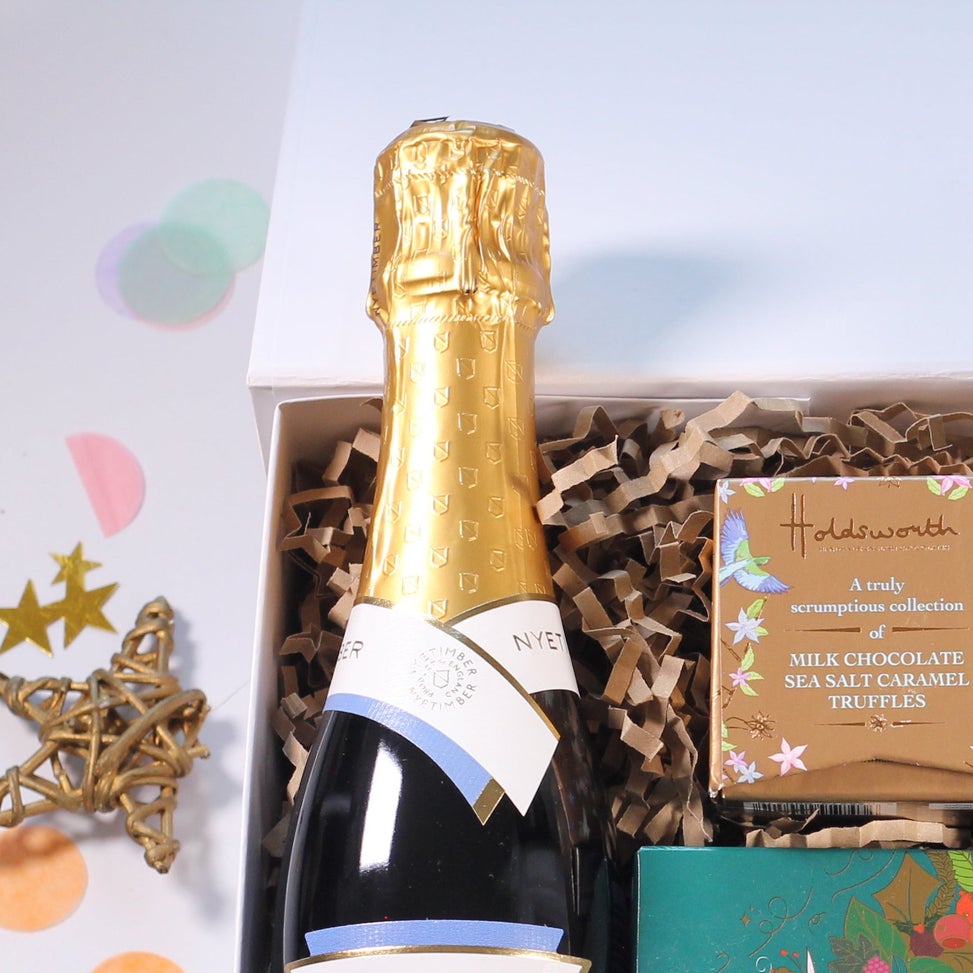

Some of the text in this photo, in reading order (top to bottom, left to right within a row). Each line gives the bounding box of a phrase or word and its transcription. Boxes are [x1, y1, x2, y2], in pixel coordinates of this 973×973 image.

[780, 492, 959, 559] Holdsworth
[849, 577, 905, 595] A truly
[790, 598, 964, 616] scrumptious collection
[868, 624, 886, 640] of
[789, 651, 965, 667] MILK CHOCOLATE
[784, 671, 970, 689] SEA SALT CARAMEL
[828, 694, 927, 710] TRUFFLES
